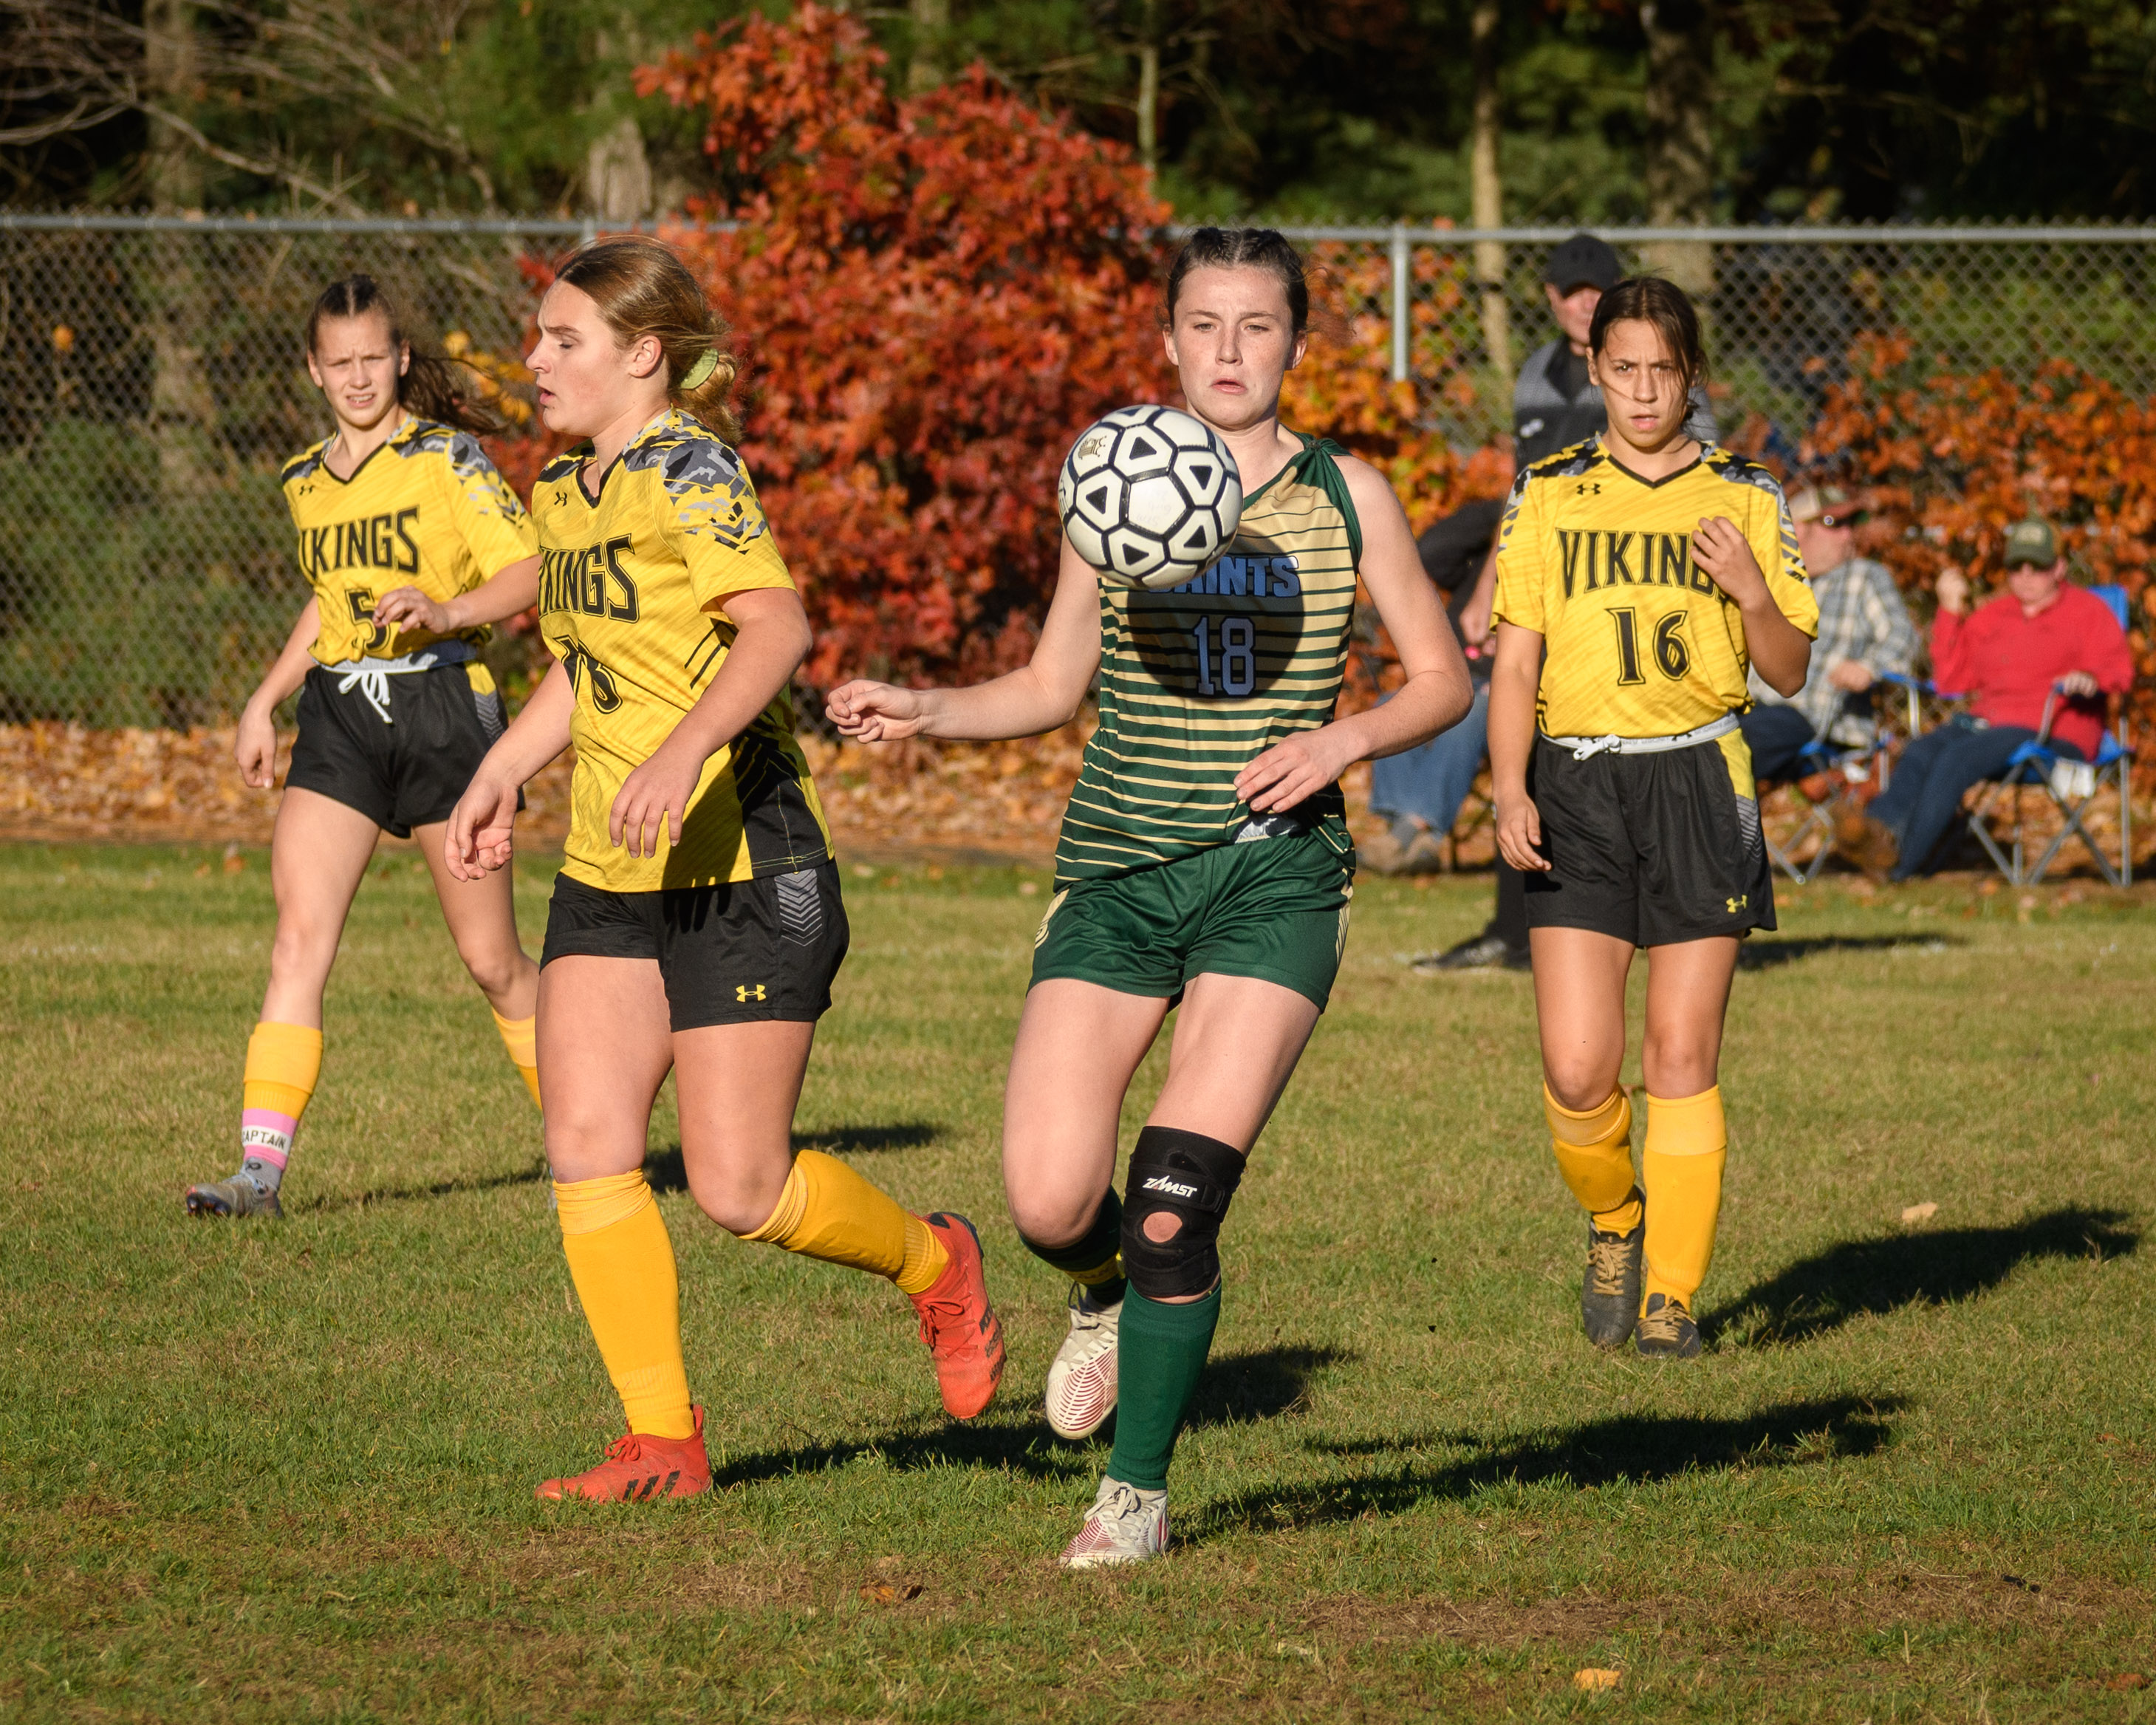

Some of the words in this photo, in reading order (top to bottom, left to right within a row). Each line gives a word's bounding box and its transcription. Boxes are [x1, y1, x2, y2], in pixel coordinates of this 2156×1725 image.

[537, 533, 640, 624] KINGS
[1147, 556, 1301, 598] INTS
[1556, 527, 1726, 602] VIKIN
[344, 587, 391, 653] 5
[1193, 615, 1255, 696] 18
[1604, 606, 1691, 686] 16
